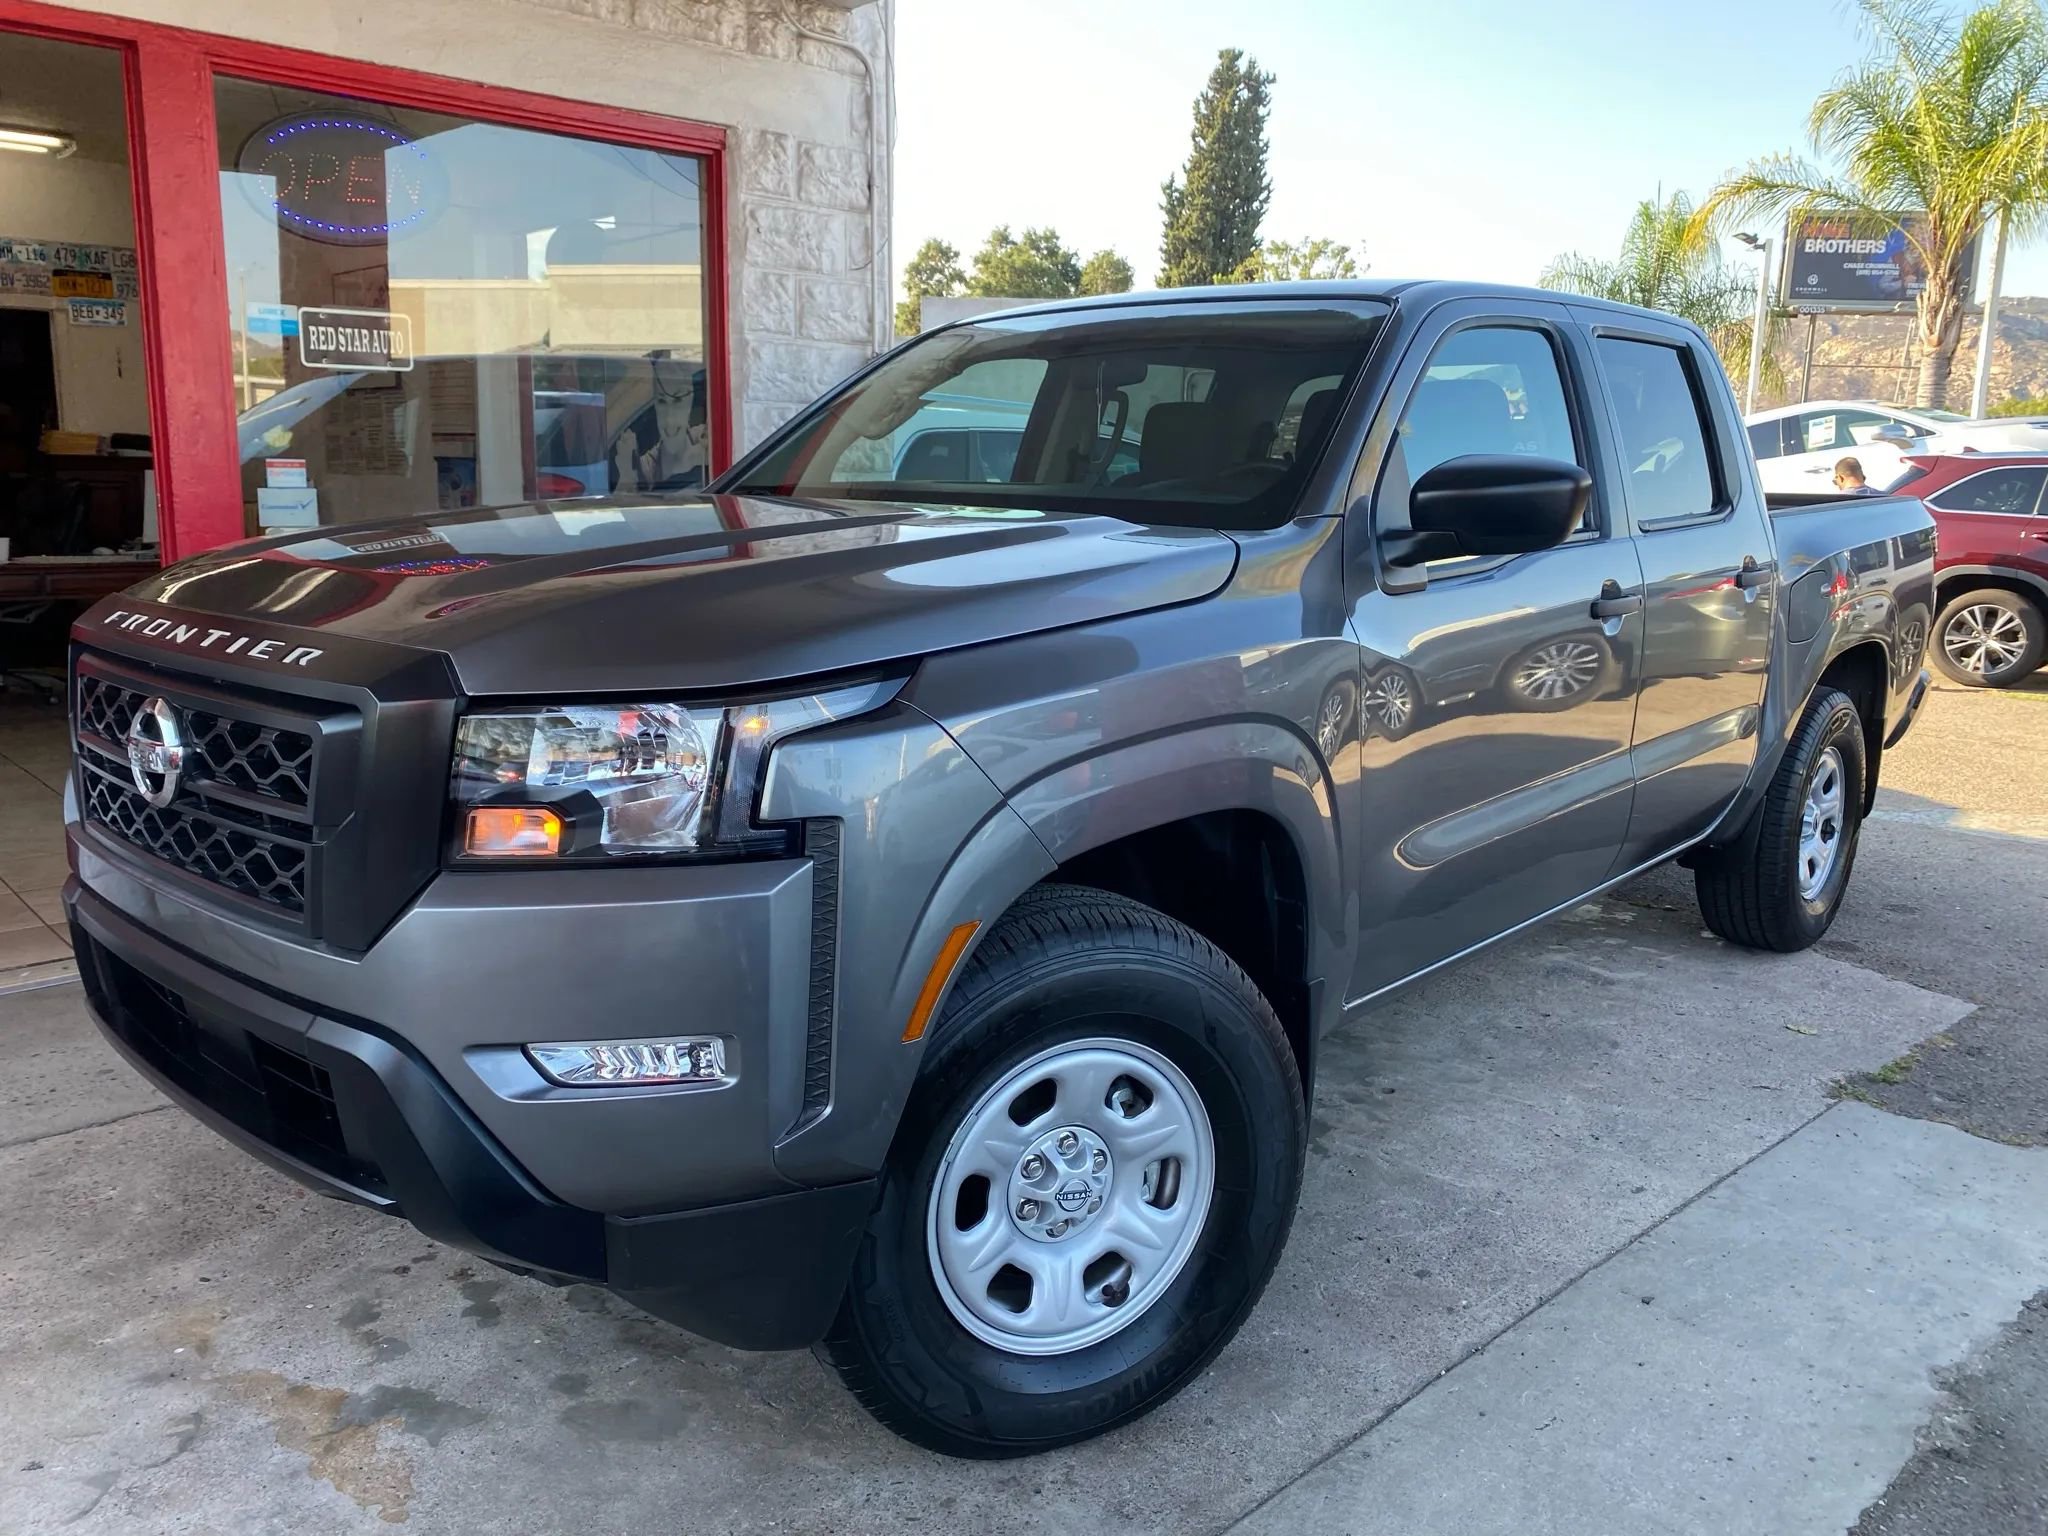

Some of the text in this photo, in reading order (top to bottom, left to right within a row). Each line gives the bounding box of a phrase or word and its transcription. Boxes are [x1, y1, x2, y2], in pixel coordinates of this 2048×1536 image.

[257, 150, 422, 205] OPEN
[1804, 239, 1887, 254] BROTHERS
[308, 325, 337, 351] RED
[338, 326, 371, 353] STAR
[372, 329, 404, 355] AUTO
[103, 610, 324, 667] FRONTIER
[1055, 1189, 1093, 1201] NISSAN
